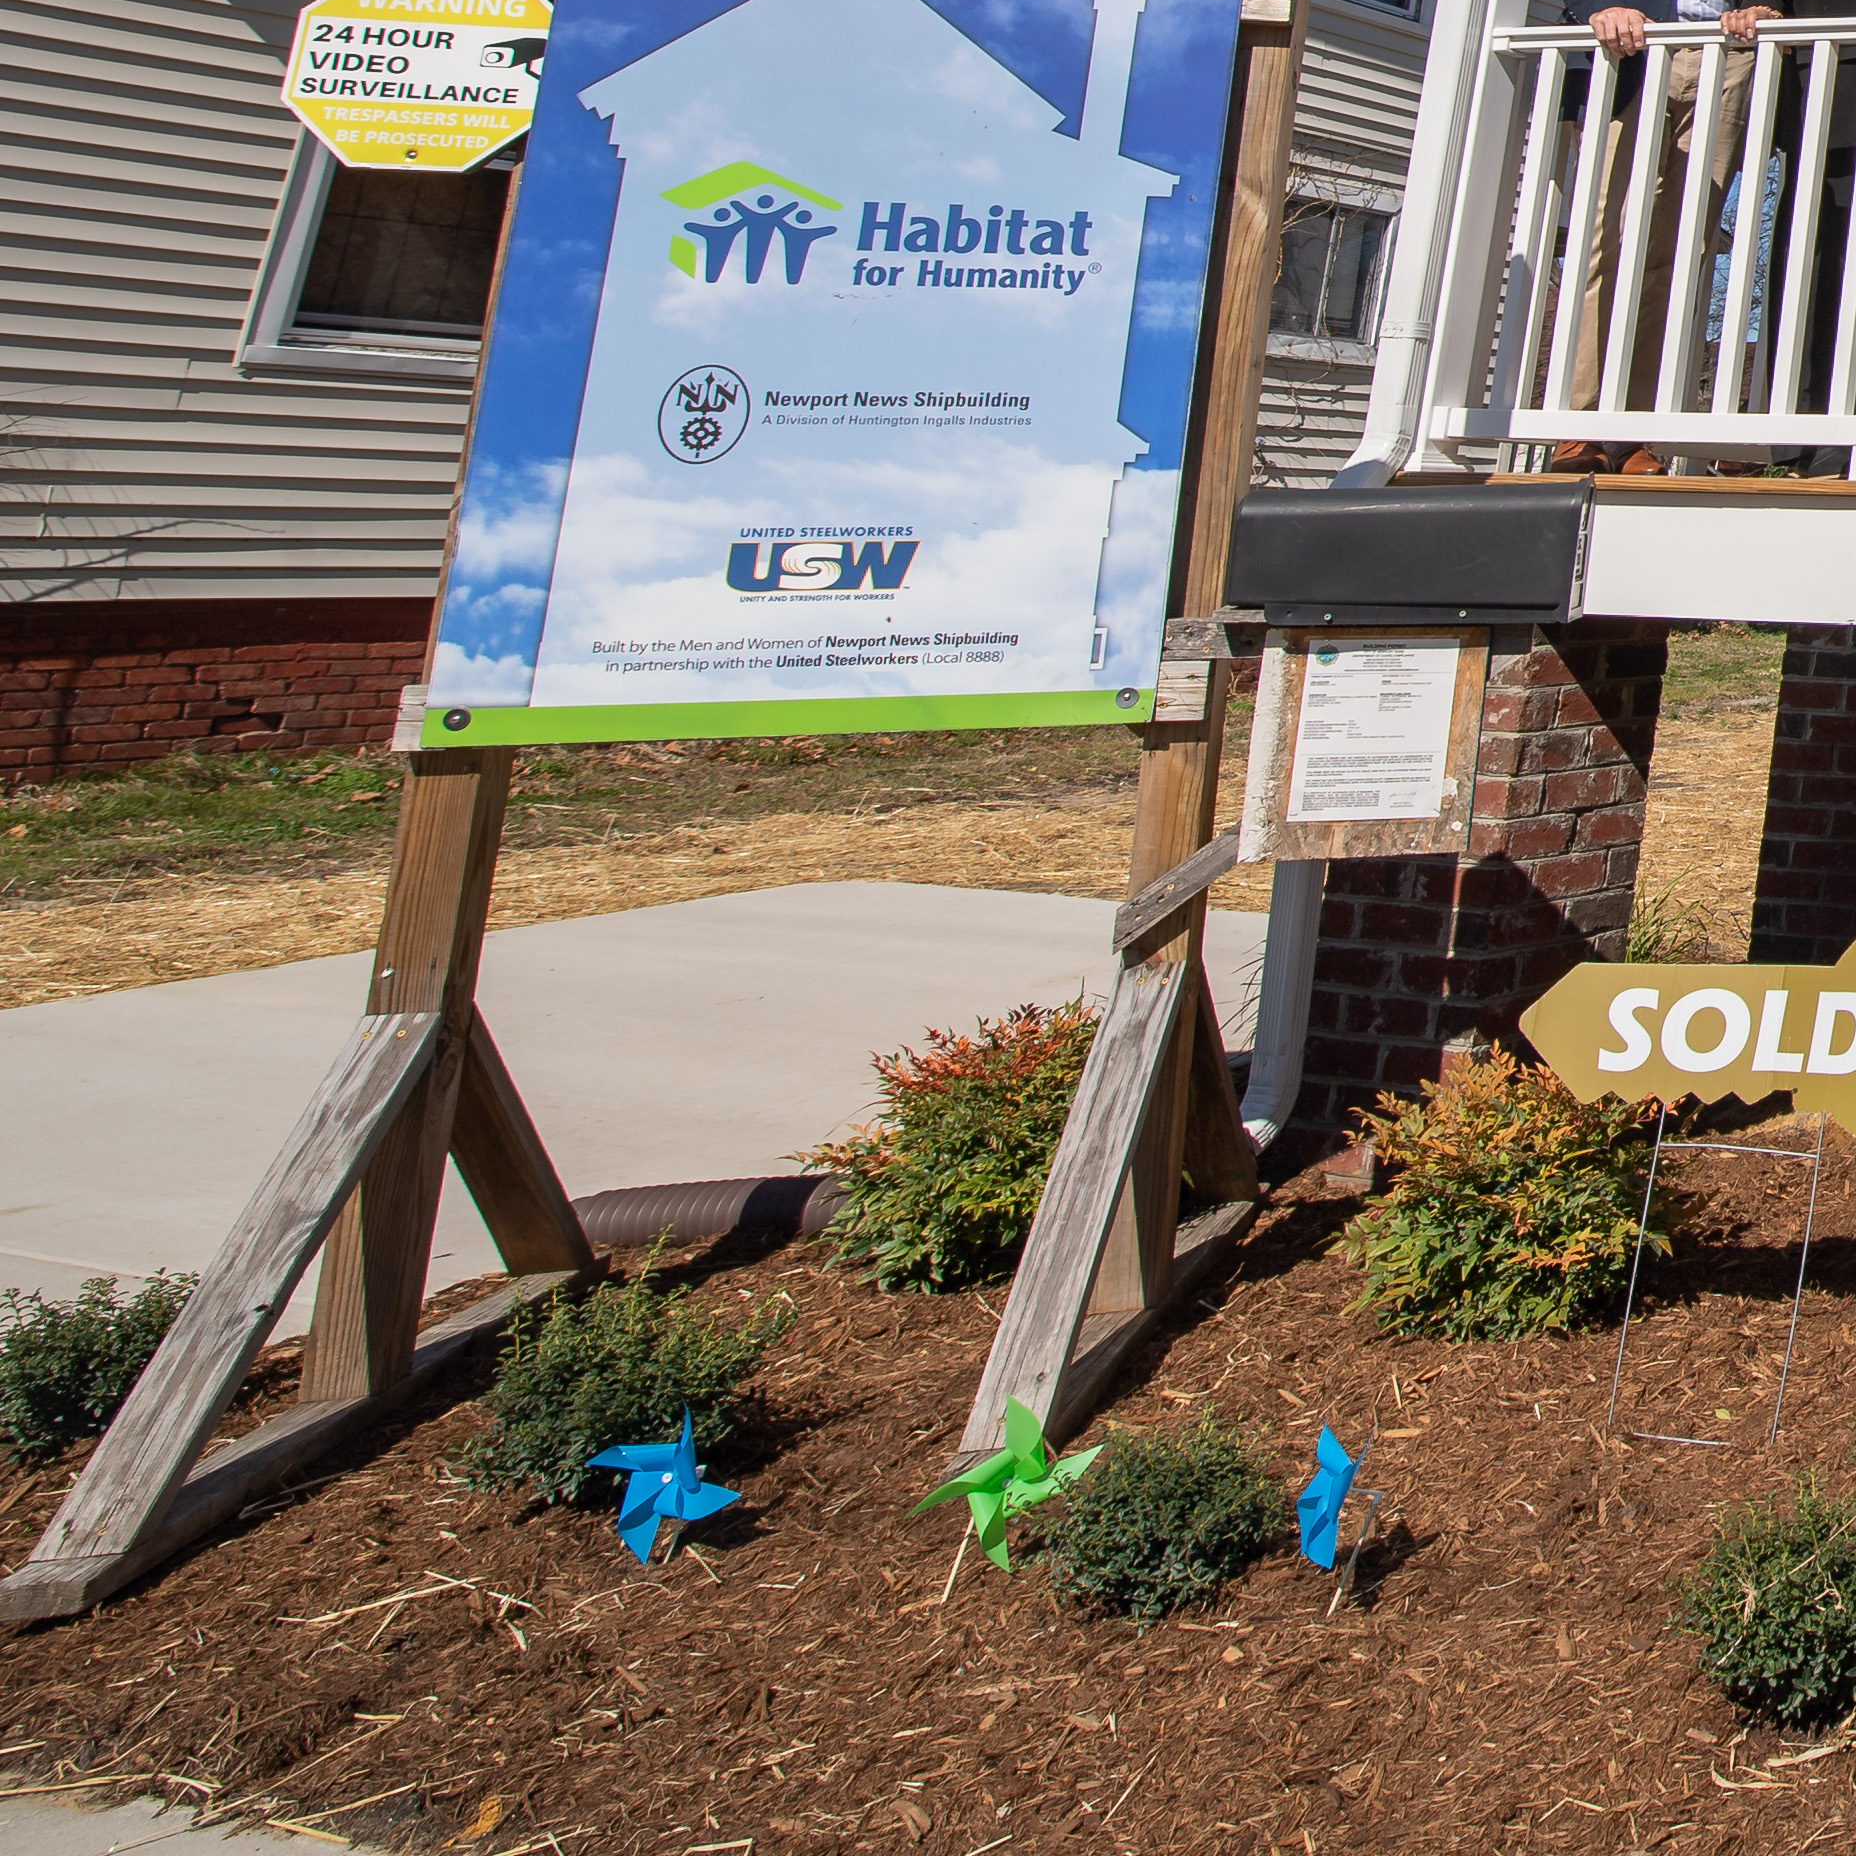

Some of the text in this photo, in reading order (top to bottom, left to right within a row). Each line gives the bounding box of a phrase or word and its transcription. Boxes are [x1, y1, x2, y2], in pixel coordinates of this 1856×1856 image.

[312, 23, 455, 50] 24 HOUR
[309, 50, 410, 74] VIDEO
[300, 78, 519, 104] SURVEILLANCE
[324, 106, 510, 129] TRESPASSERS WILL
[335, 130, 489, 149] BE PROSECUTED
[856, 201, 1093, 257] Habitat
[853, 258, 905, 287] for
[764, 391, 1031, 412] Newport News Shipbuilding
[762, 414, 1032, 428] A Division of Huntington Ingalls Industries
[740, 526, 914, 538] UNITED STEELWORKERS
[726, 540, 921, 592] USW
[740, 593, 895, 603] UNITY AND STRENGTH FOR WORKERS
[592, 632, 1019, 657] Built by the Men and Women of Newport News Shipbuilding
[606, 650, 1005, 675] in partnership with the United Steelworkers (Local 8888)
